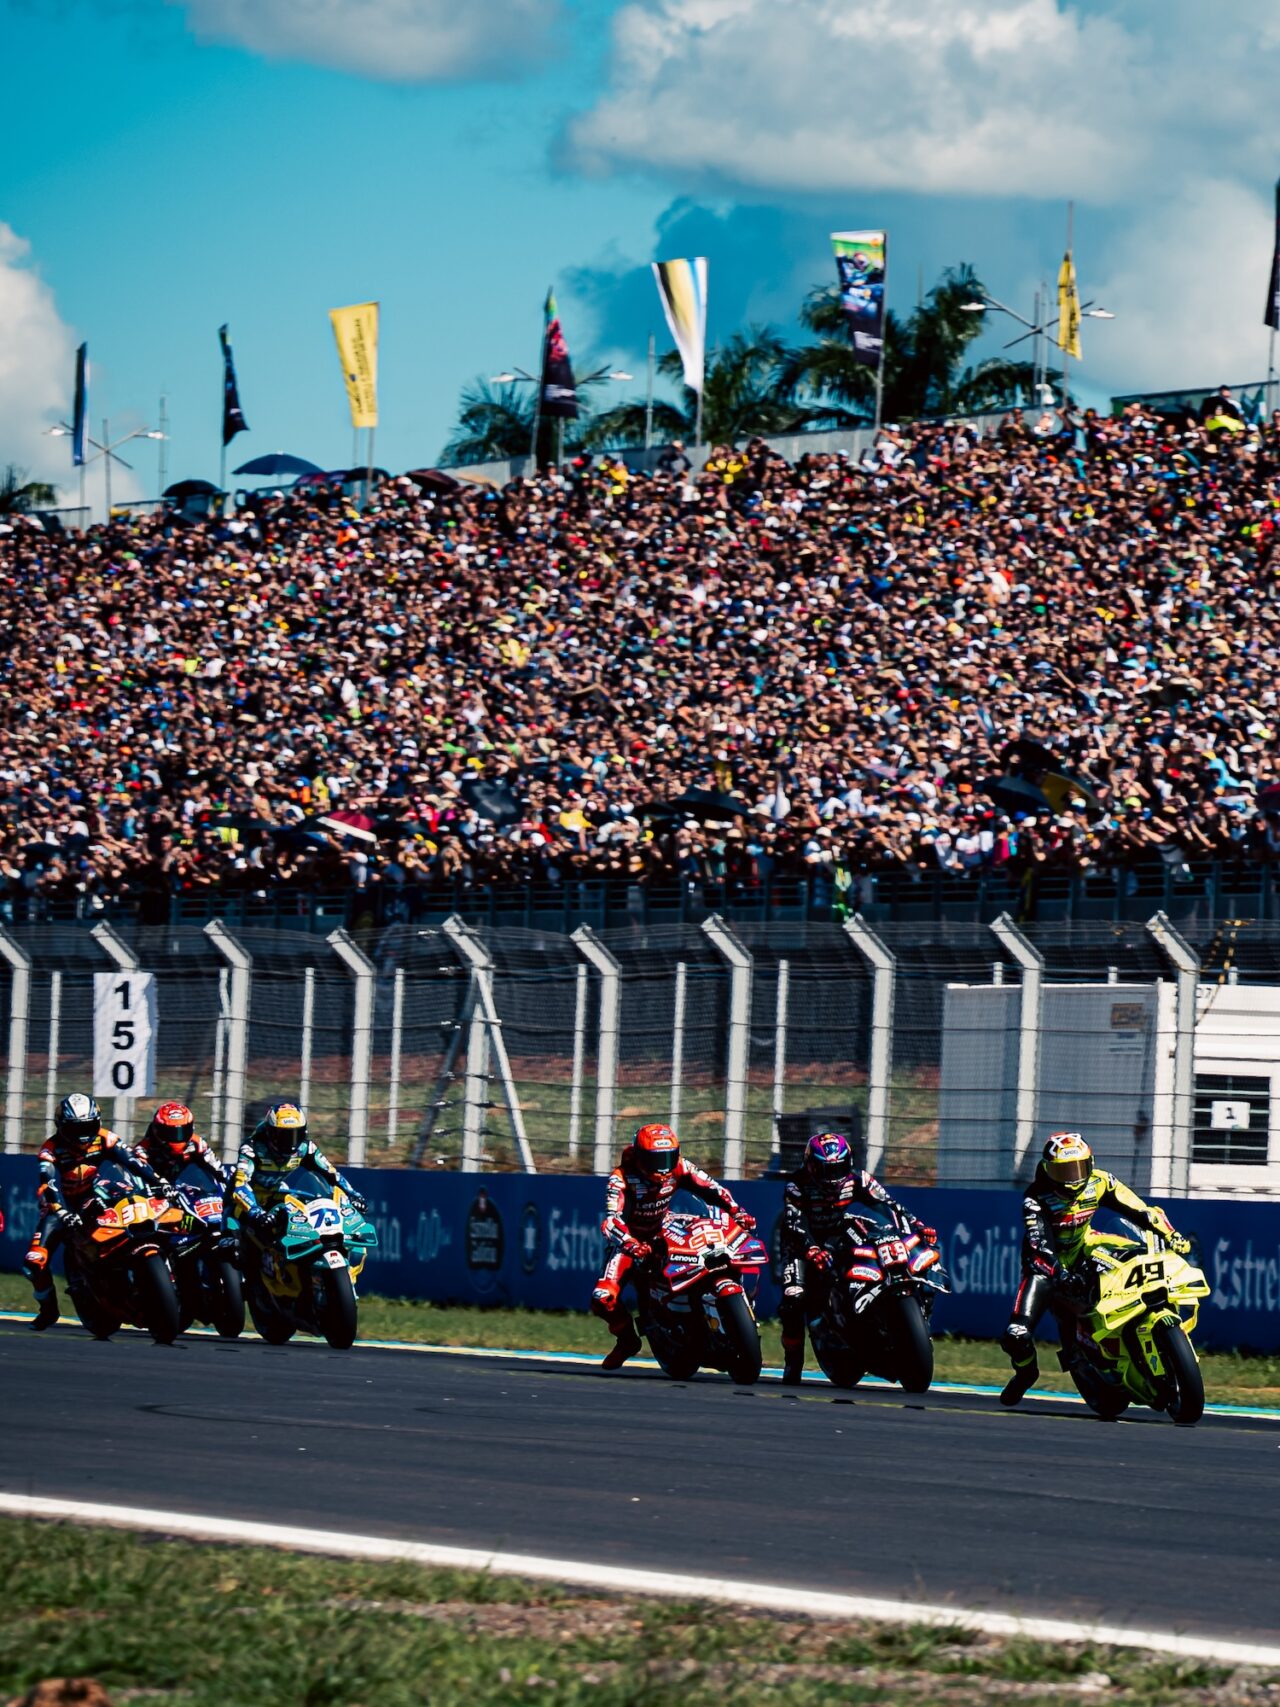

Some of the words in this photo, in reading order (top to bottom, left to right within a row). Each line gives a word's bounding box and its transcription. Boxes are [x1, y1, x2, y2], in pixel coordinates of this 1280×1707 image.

[112, 980, 135, 1090] 150
[1225, 1107, 1235, 1120] 1
[121, 1202, 149, 1226] 37
[309, 1207, 342, 1230] 73
[670, 1254, 698, 1263] Lenovo
[879, 1242, 908, 1267] 89
[949, 1222, 1022, 1295] Galici
[1124, 1261, 1165, 1290] 49
